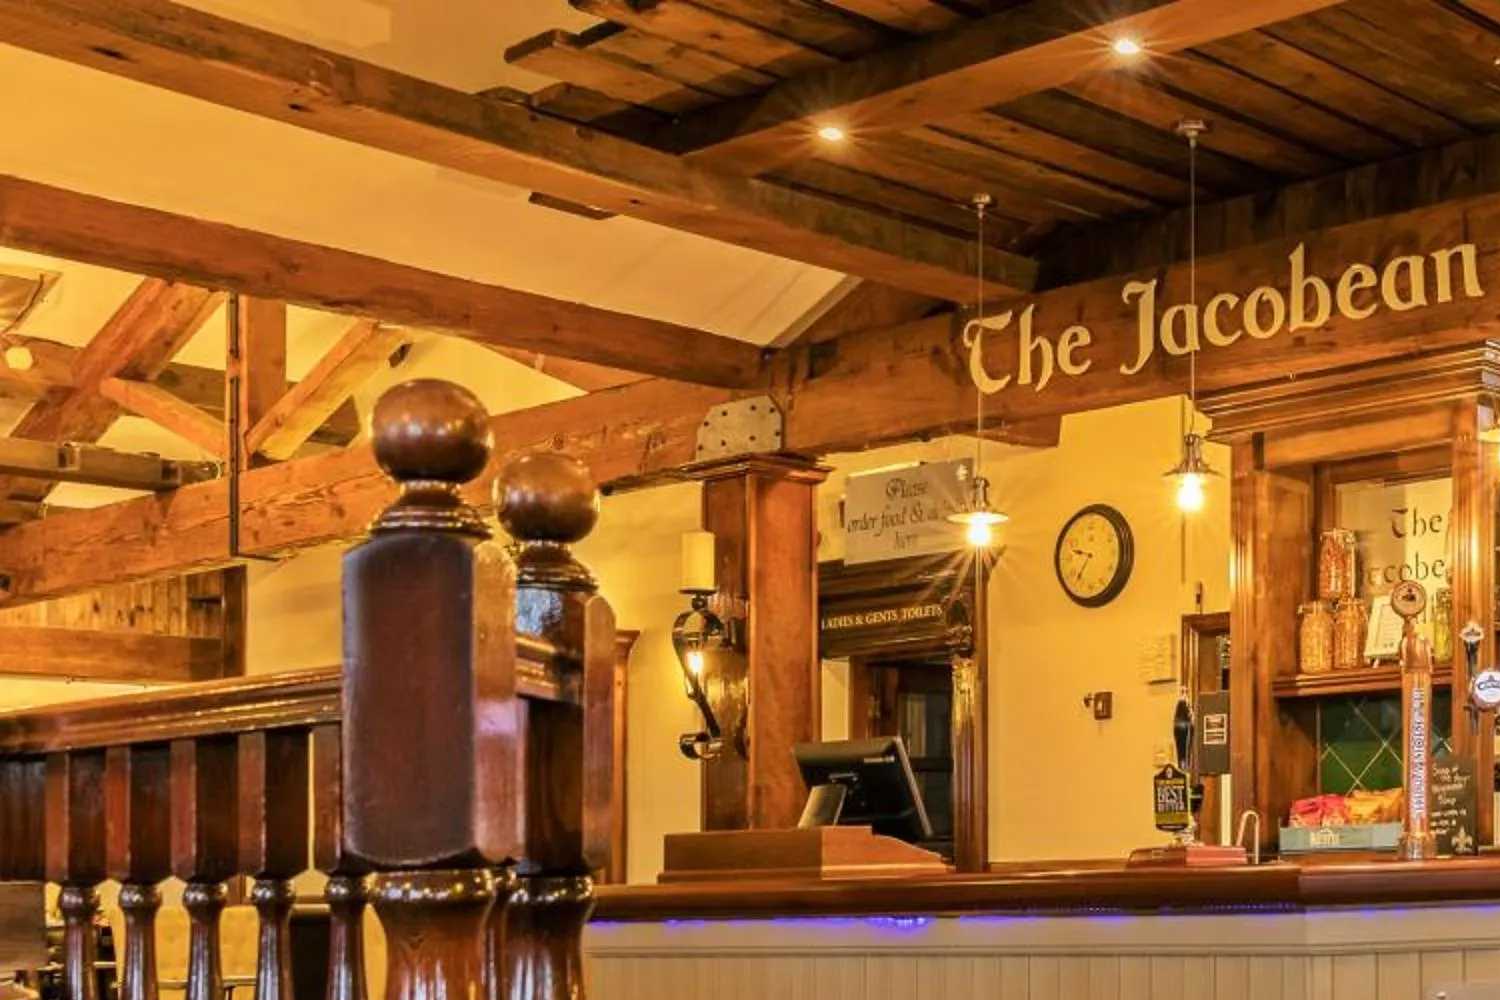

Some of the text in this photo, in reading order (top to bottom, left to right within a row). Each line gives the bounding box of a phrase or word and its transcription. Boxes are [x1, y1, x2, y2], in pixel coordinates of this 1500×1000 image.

[963, 303, 1090, 394] The
[1120, 242, 1484, 375] Jacobean
[885, 477, 929, 500] Please
[847, 512, 877, 533] order
[875, 504, 907, 537] food
[910, 502, 924, 524] &
[1391, 507, 1443, 539] The
[821, 615, 853, 630] LADIES
[855, 614, 864, 625] &
[902, 604, 943, 620] TOILETS
[1157, 785, 1185, 803] BEST
[1157, 801, 1185, 814] BITTER
